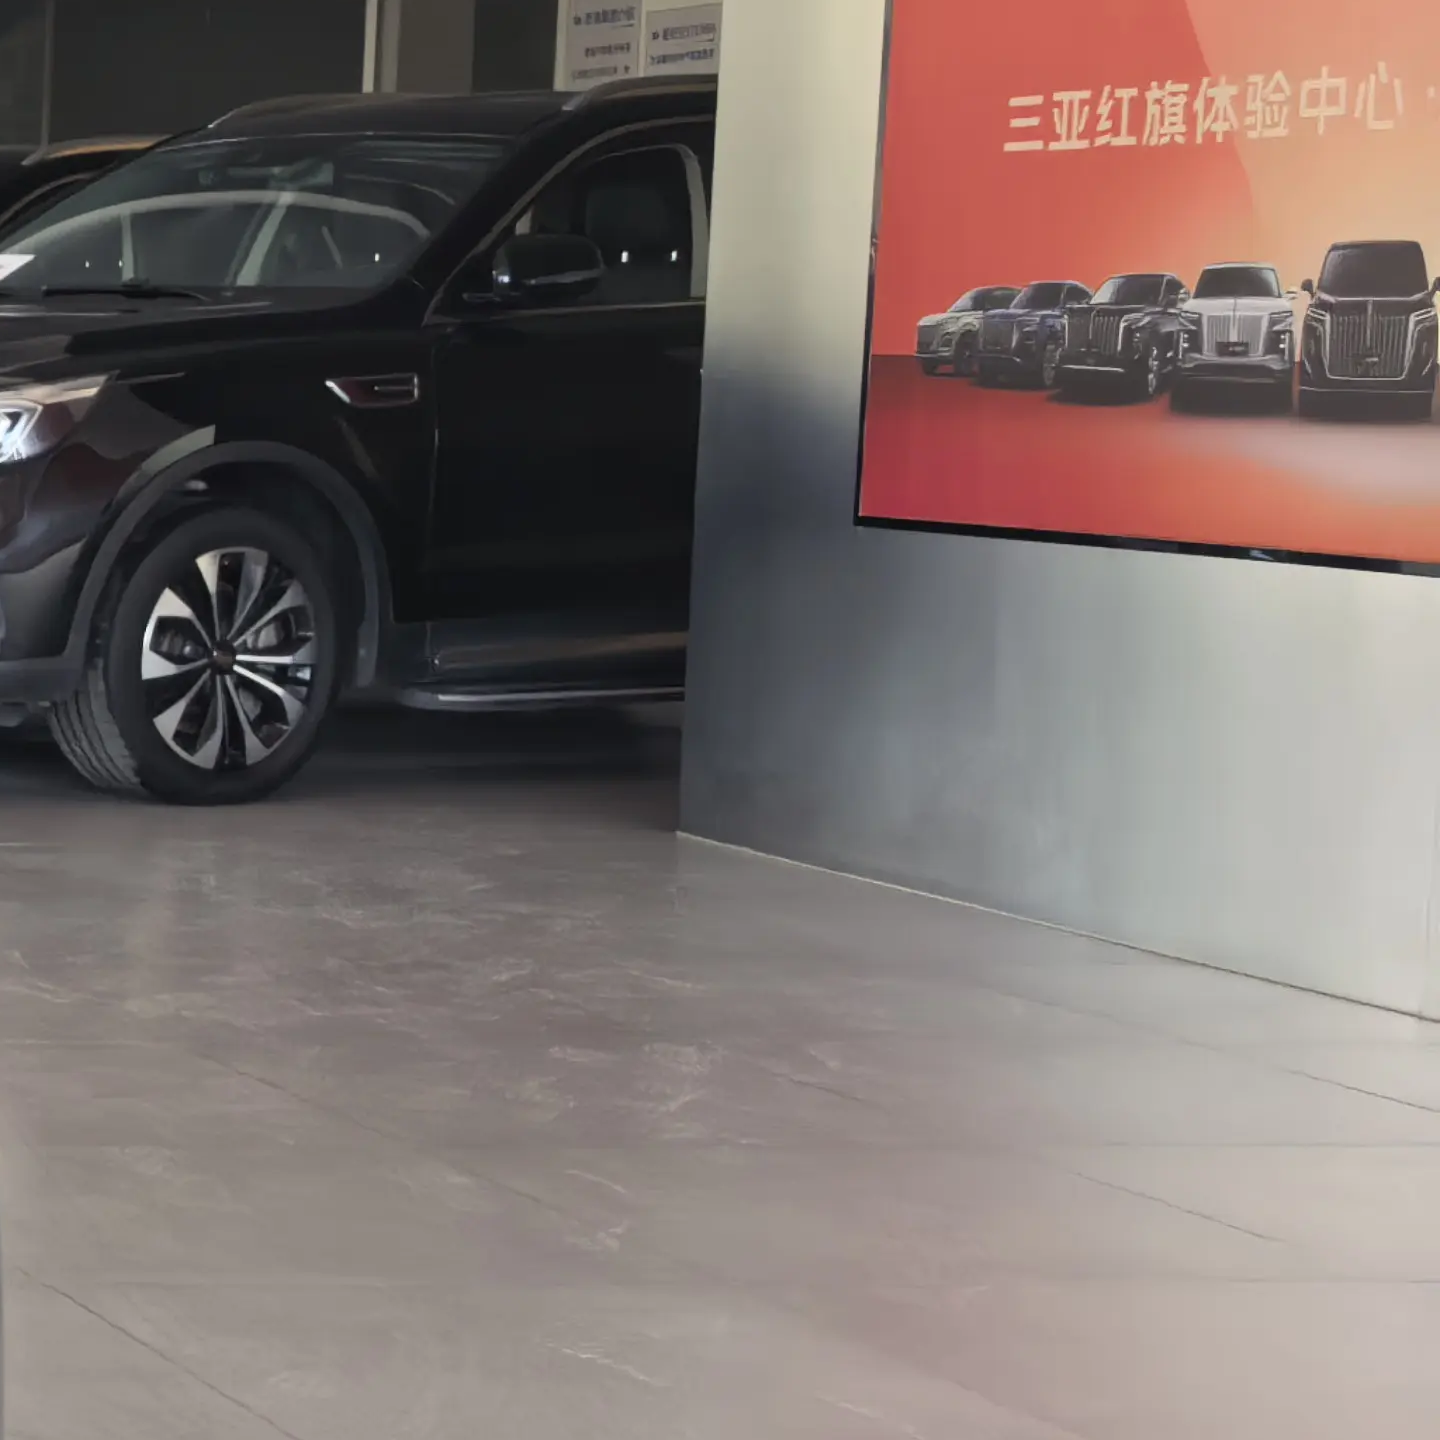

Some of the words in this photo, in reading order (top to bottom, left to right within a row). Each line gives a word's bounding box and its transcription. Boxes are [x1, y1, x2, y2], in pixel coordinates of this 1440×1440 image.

[1003, 61, 1405, 153] 三亚红旗体验中心
